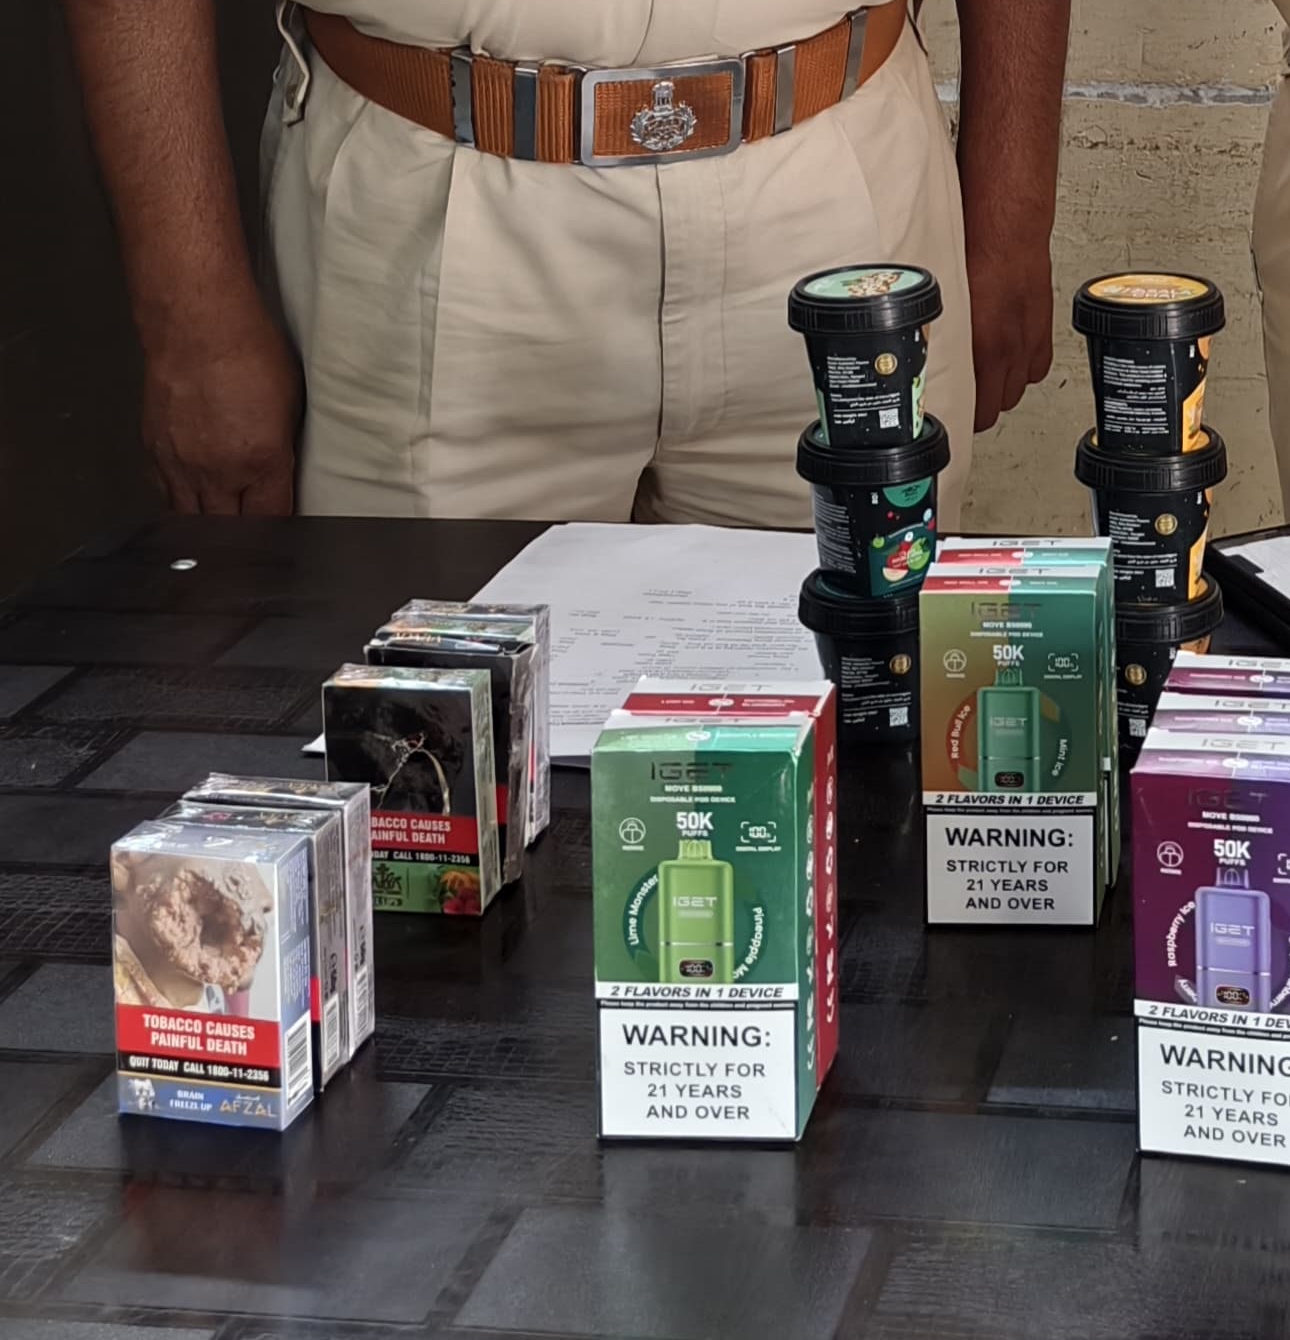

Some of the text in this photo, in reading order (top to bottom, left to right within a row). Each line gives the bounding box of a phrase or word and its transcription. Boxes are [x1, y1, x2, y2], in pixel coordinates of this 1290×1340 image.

[993, 645, 1025, 661] 50K
[950, 740, 960, 759] Red
[1056, 738, 1068, 760] Mint
[1201, 738, 1287, 751] IGET
[651, 762, 735, 781] IGET
[936, 794, 1085, 805] 2 FLAVORS IN 1 DEVICE
[371, 817, 451, 832] BACCO CAUSES
[676, 811, 714, 831] 50K
[371, 830, 446, 845] AINFUL DEATH
[945, 827, 1074, 848] WARNING:
[393, 851, 413, 861] CALL
[1213, 839, 1251, 859] 50K
[946, 860, 1069, 874] STRICTLY FOR
[966, 879, 1049, 892] 21 YEARS
[629, 874, 659, 917] Monster
[672, 896, 718, 908] IGET
[965, 897, 1055, 910] AND OVER
[628, 916, 640, 946] Lime
[745, 906, 765, 965] Pineapple
[1166, 900, 1197, 968] Raspberry Ice
[1210, 922, 1255, 936] IGET
[610, 985, 784, 998] 2 FLAVORS IN 1 DEVICE
[1149, 1005, 1158, 1016] 2
[1162, 1007, 1229, 1024] FLAVORS
[1232, 1013, 1249, 1025] IN
[1253, 1015, 1260, 1027] 1
[143, 1013, 255, 1040] TOBACCO CAUSES
[622, 1023, 771, 1048] WARNING:
[151, 1032, 248, 1056] PAINFUL DEATH
[129, 1055, 270, 1082] QUIT TODAY CALL 1800-11-2356
[624, 1060, 766, 1078] STRICTLY FOR
[177, 1089, 205, 1100] BRAIN
[647, 1083, 743, 1099] 21 YEARS
[1161, 1080, 1254, 1103] STRICTLY
[200, 1102, 213, 1112] UP
[219, 1099, 278, 1118] AFZAL
[646, 1105, 751, 1120] AND OVER
[1184, 1104, 1279, 1127] 21 YEARS
[1183, 1124, 1287, 1149] AND OVER
